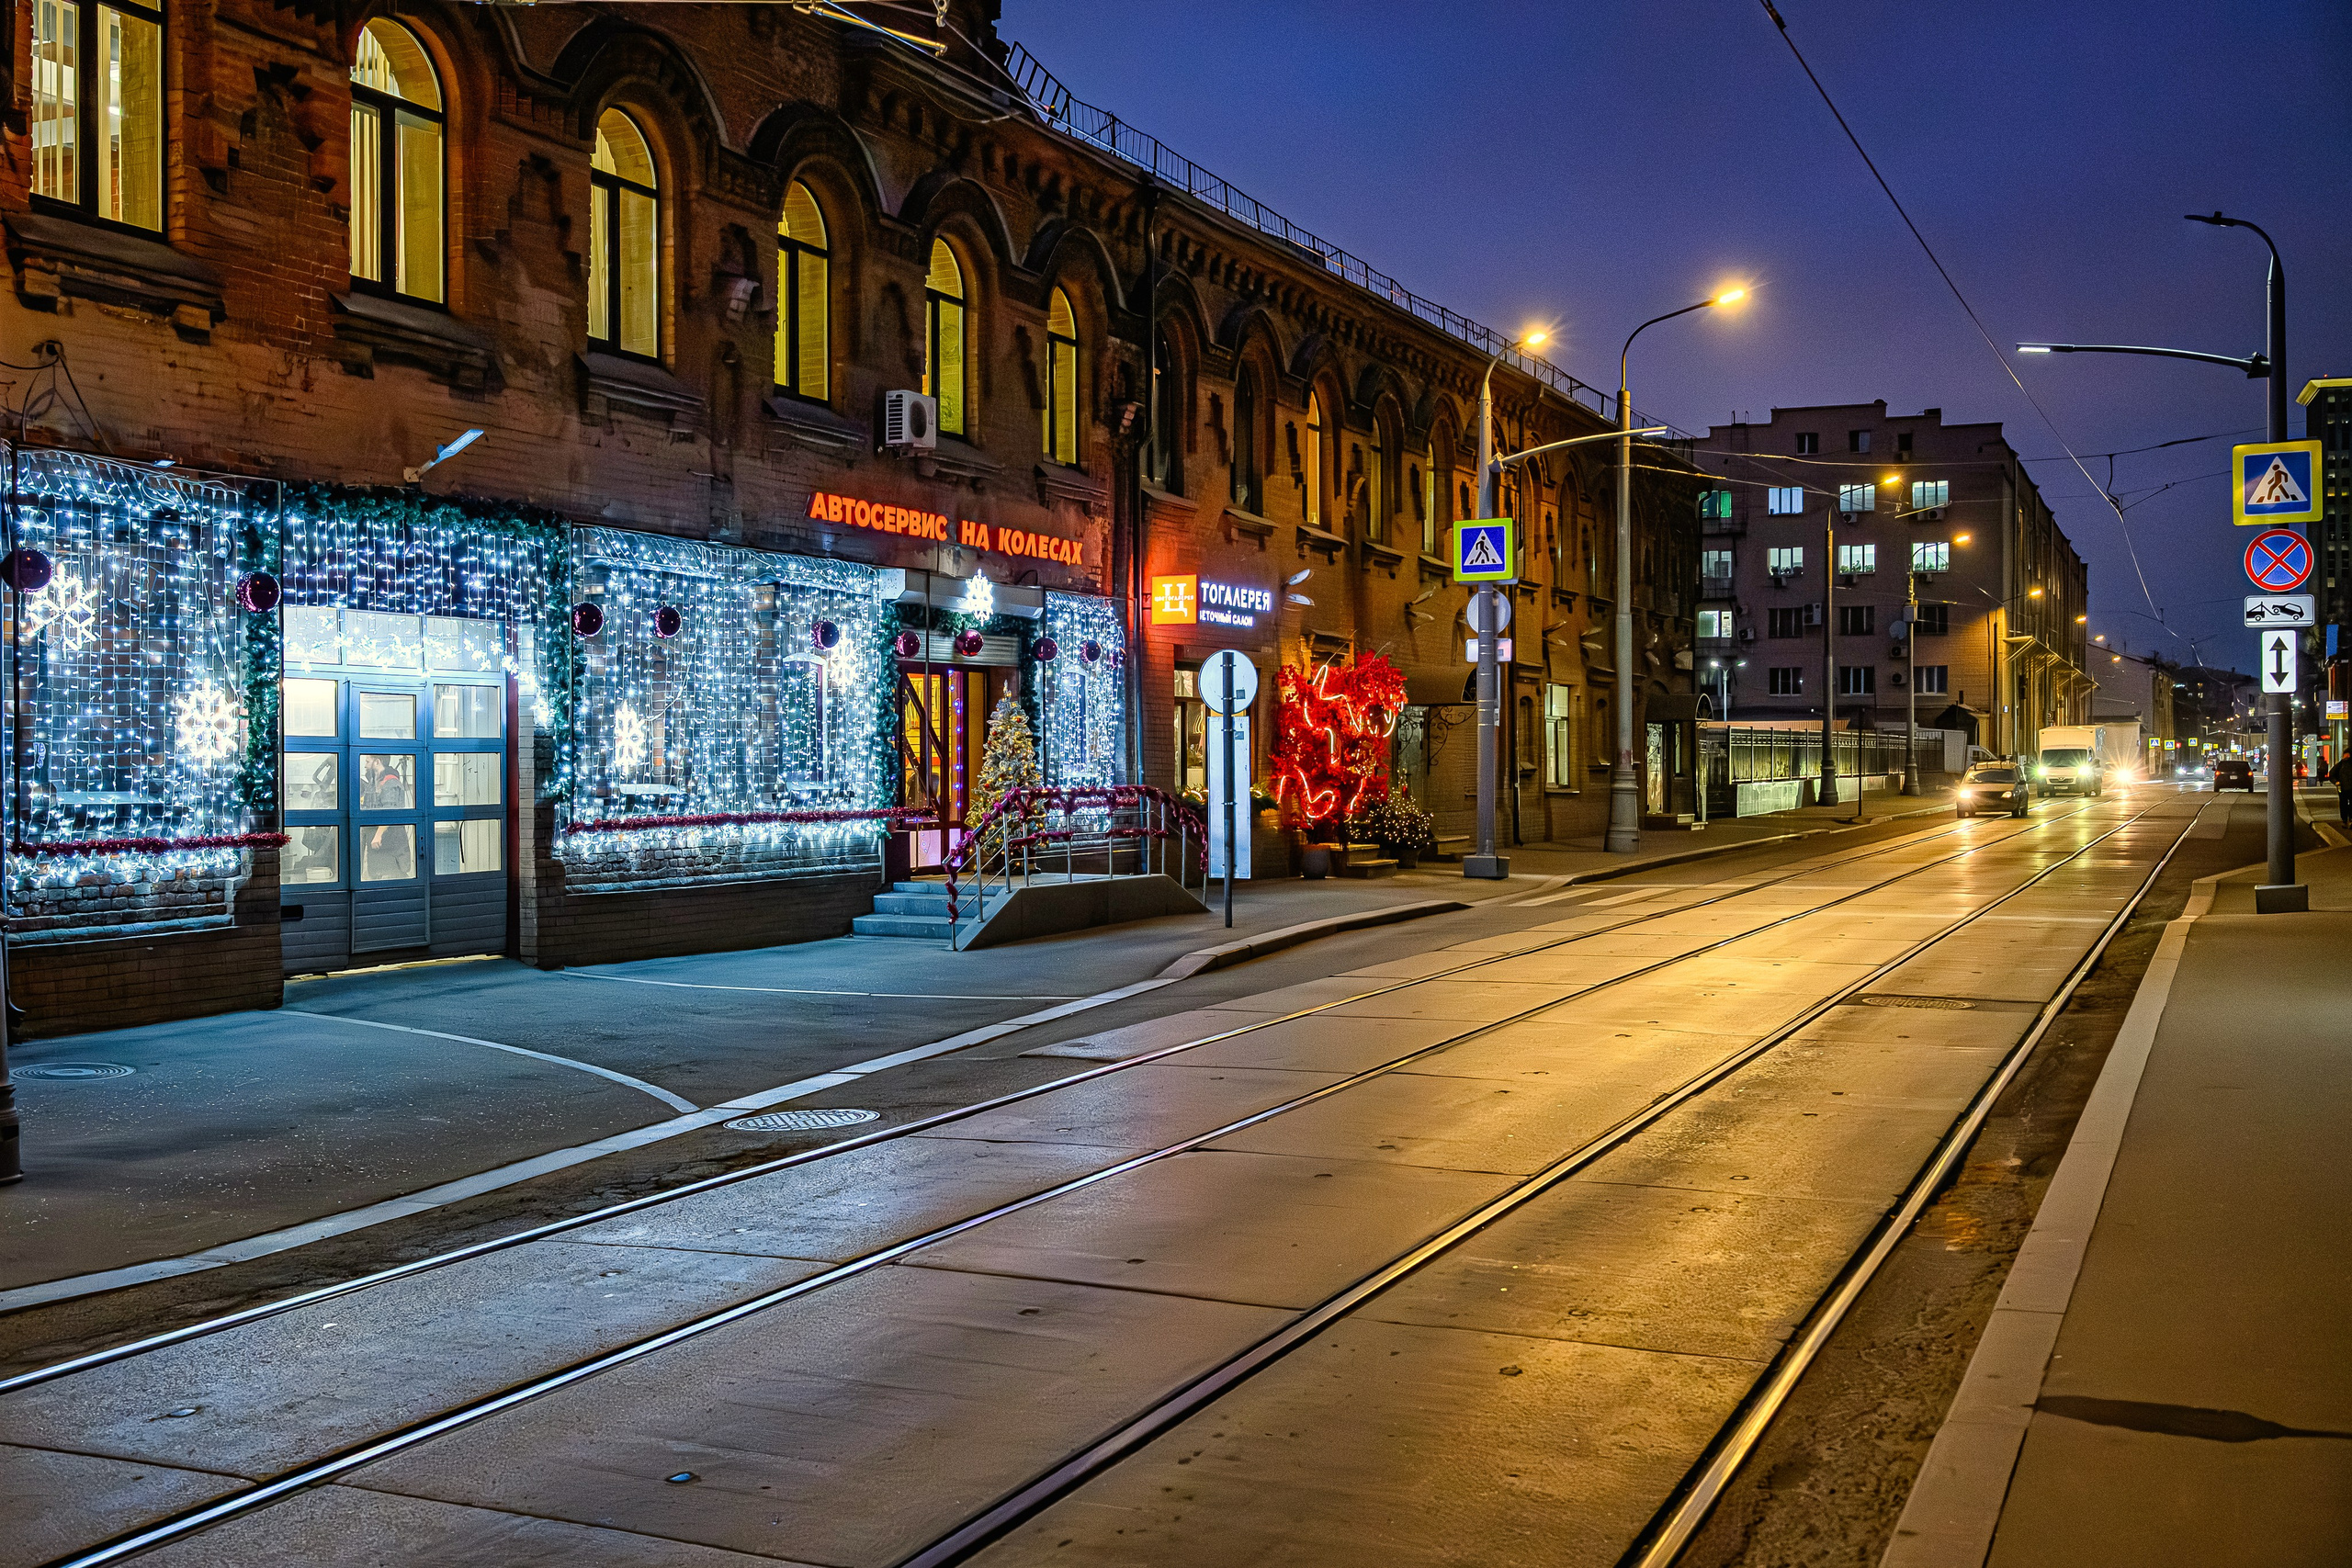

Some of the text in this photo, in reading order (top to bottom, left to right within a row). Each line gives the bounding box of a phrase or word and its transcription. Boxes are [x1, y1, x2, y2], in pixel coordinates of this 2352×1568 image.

[809, 491, 1083, 566] АВТОСЕРВИС НА КОЛЕСАХ
[1161, 583, 1188, 617] Ц
[1232, 614, 1253, 626] САЛОН
